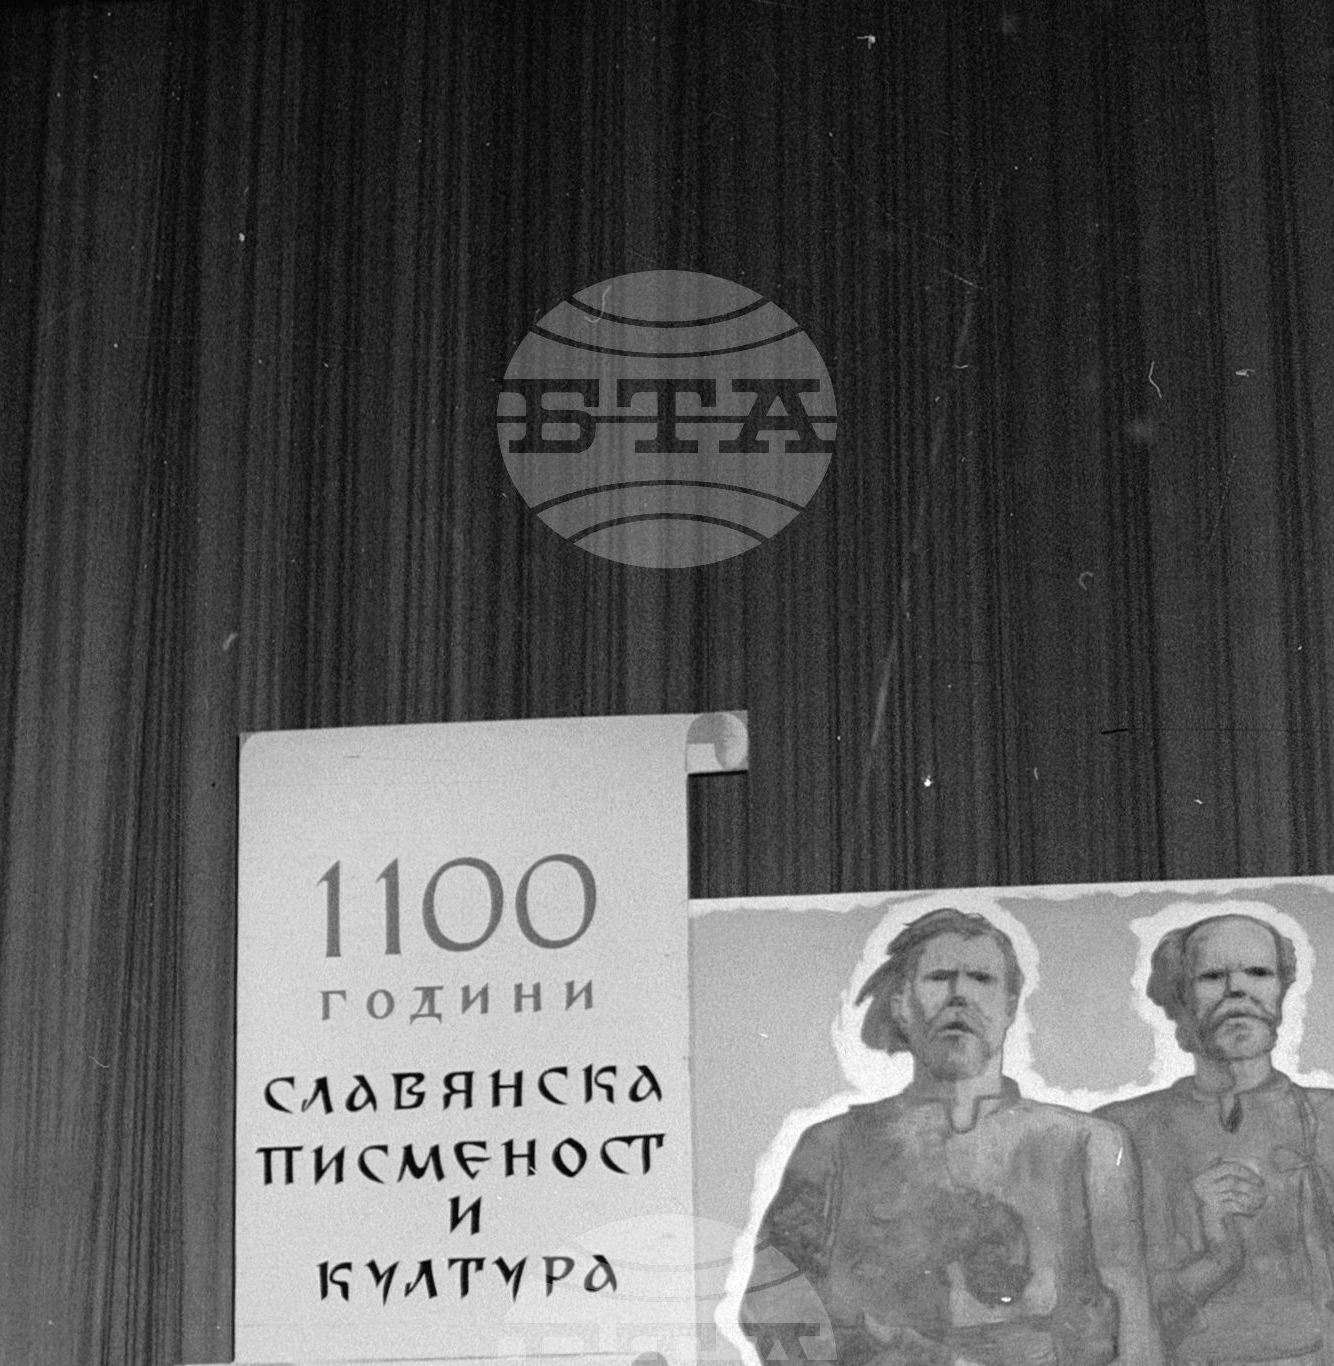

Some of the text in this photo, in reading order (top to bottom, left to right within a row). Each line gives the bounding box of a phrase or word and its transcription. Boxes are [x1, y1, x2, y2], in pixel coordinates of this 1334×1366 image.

[316, 852, 599, 959] 1100
[262, 1062, 664, 1115] СЛАВЯНСКА
[254, 1131, 667, 1186] ПИСМЕНОСТ
[447, 1194, 484, 1236] И
[315, 1252, 620, 1307] КУЛТУРА
